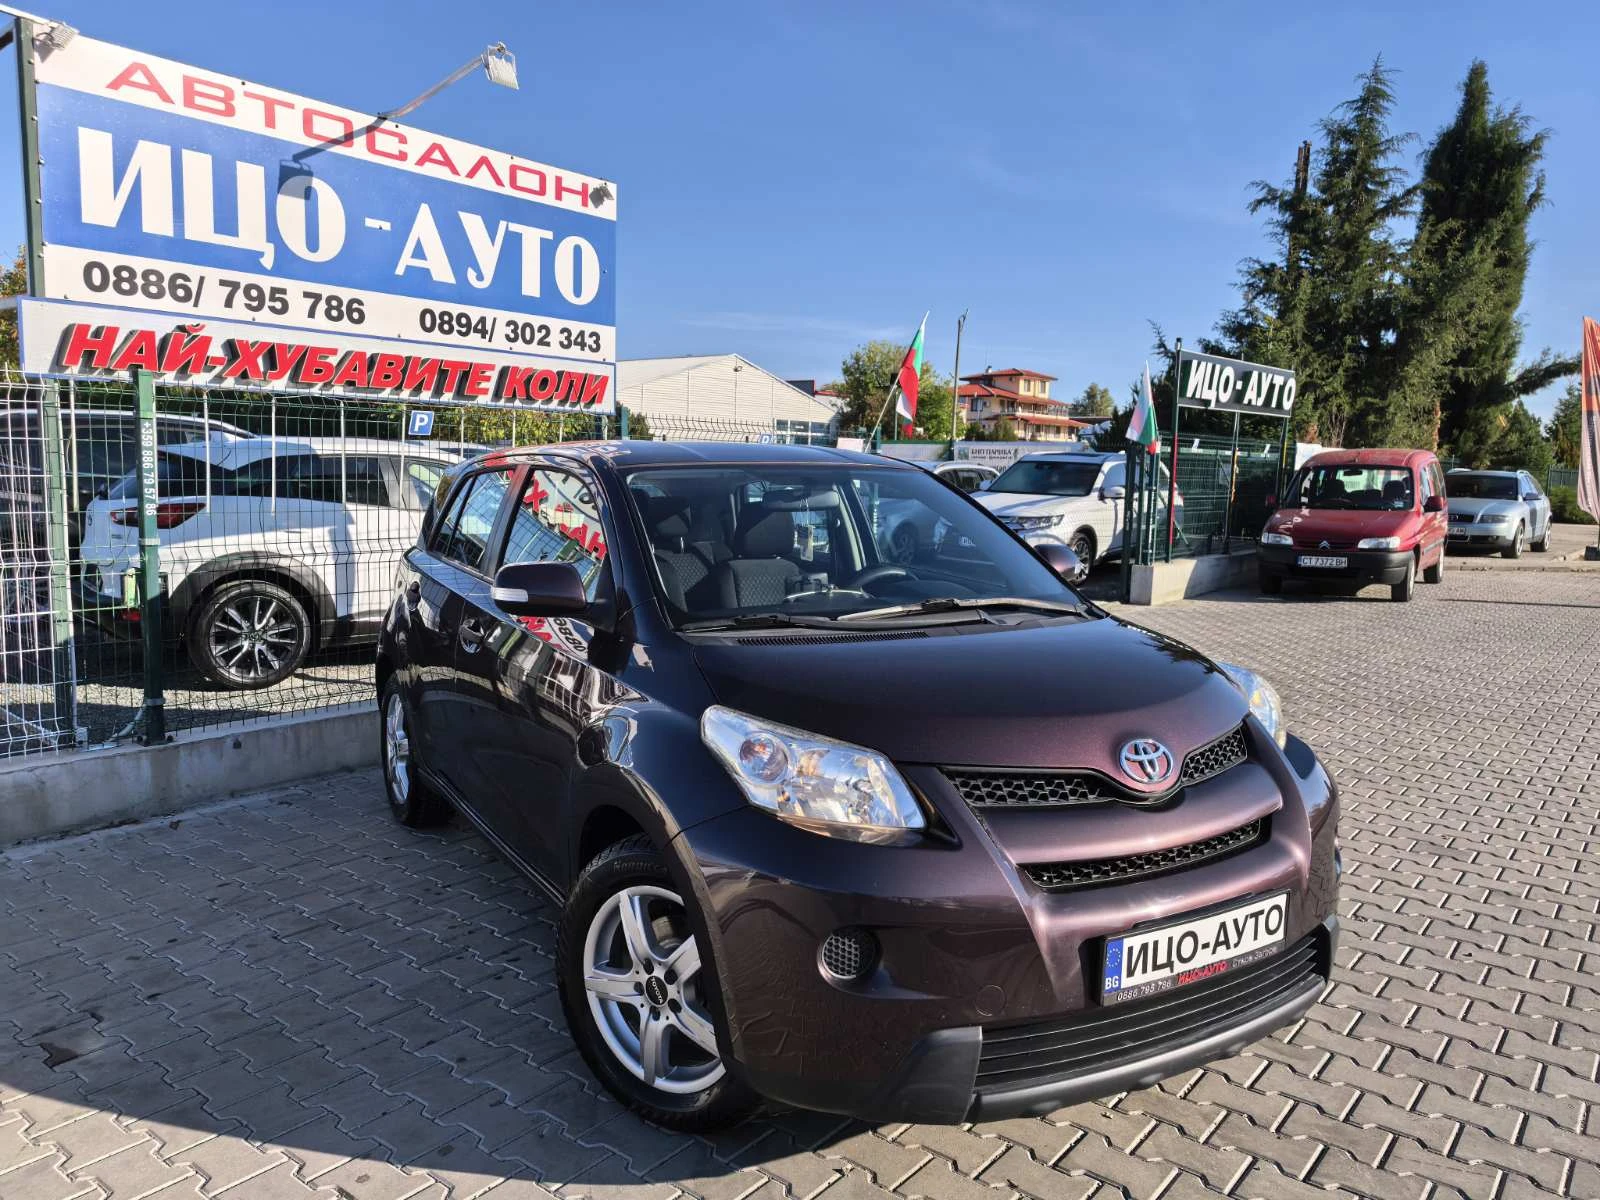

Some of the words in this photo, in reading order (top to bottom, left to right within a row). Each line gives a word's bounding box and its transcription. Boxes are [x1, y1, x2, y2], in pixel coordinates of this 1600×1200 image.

[106, 61, 590, 208] АВТОСАЛОН
[82, 260, 205, 308] 0886/
[218, 279, 289, 316] 795
[302, 291, 366, 325] 786
[419, 308, 497, 342] 0894/
[504, 319, 551, 347] 302
[559, 327, 601, 353] 343
[61, 323, 496, 400] НАЙ-ХУБАВИТЕ
[502, 365, 610, 406] КОЛИ
[414, 413, 429, 432] P
[142, 451, 153, 469] 886
[145, 503, 157, 516] 86
[1105, 976, 1119, 990] BG
